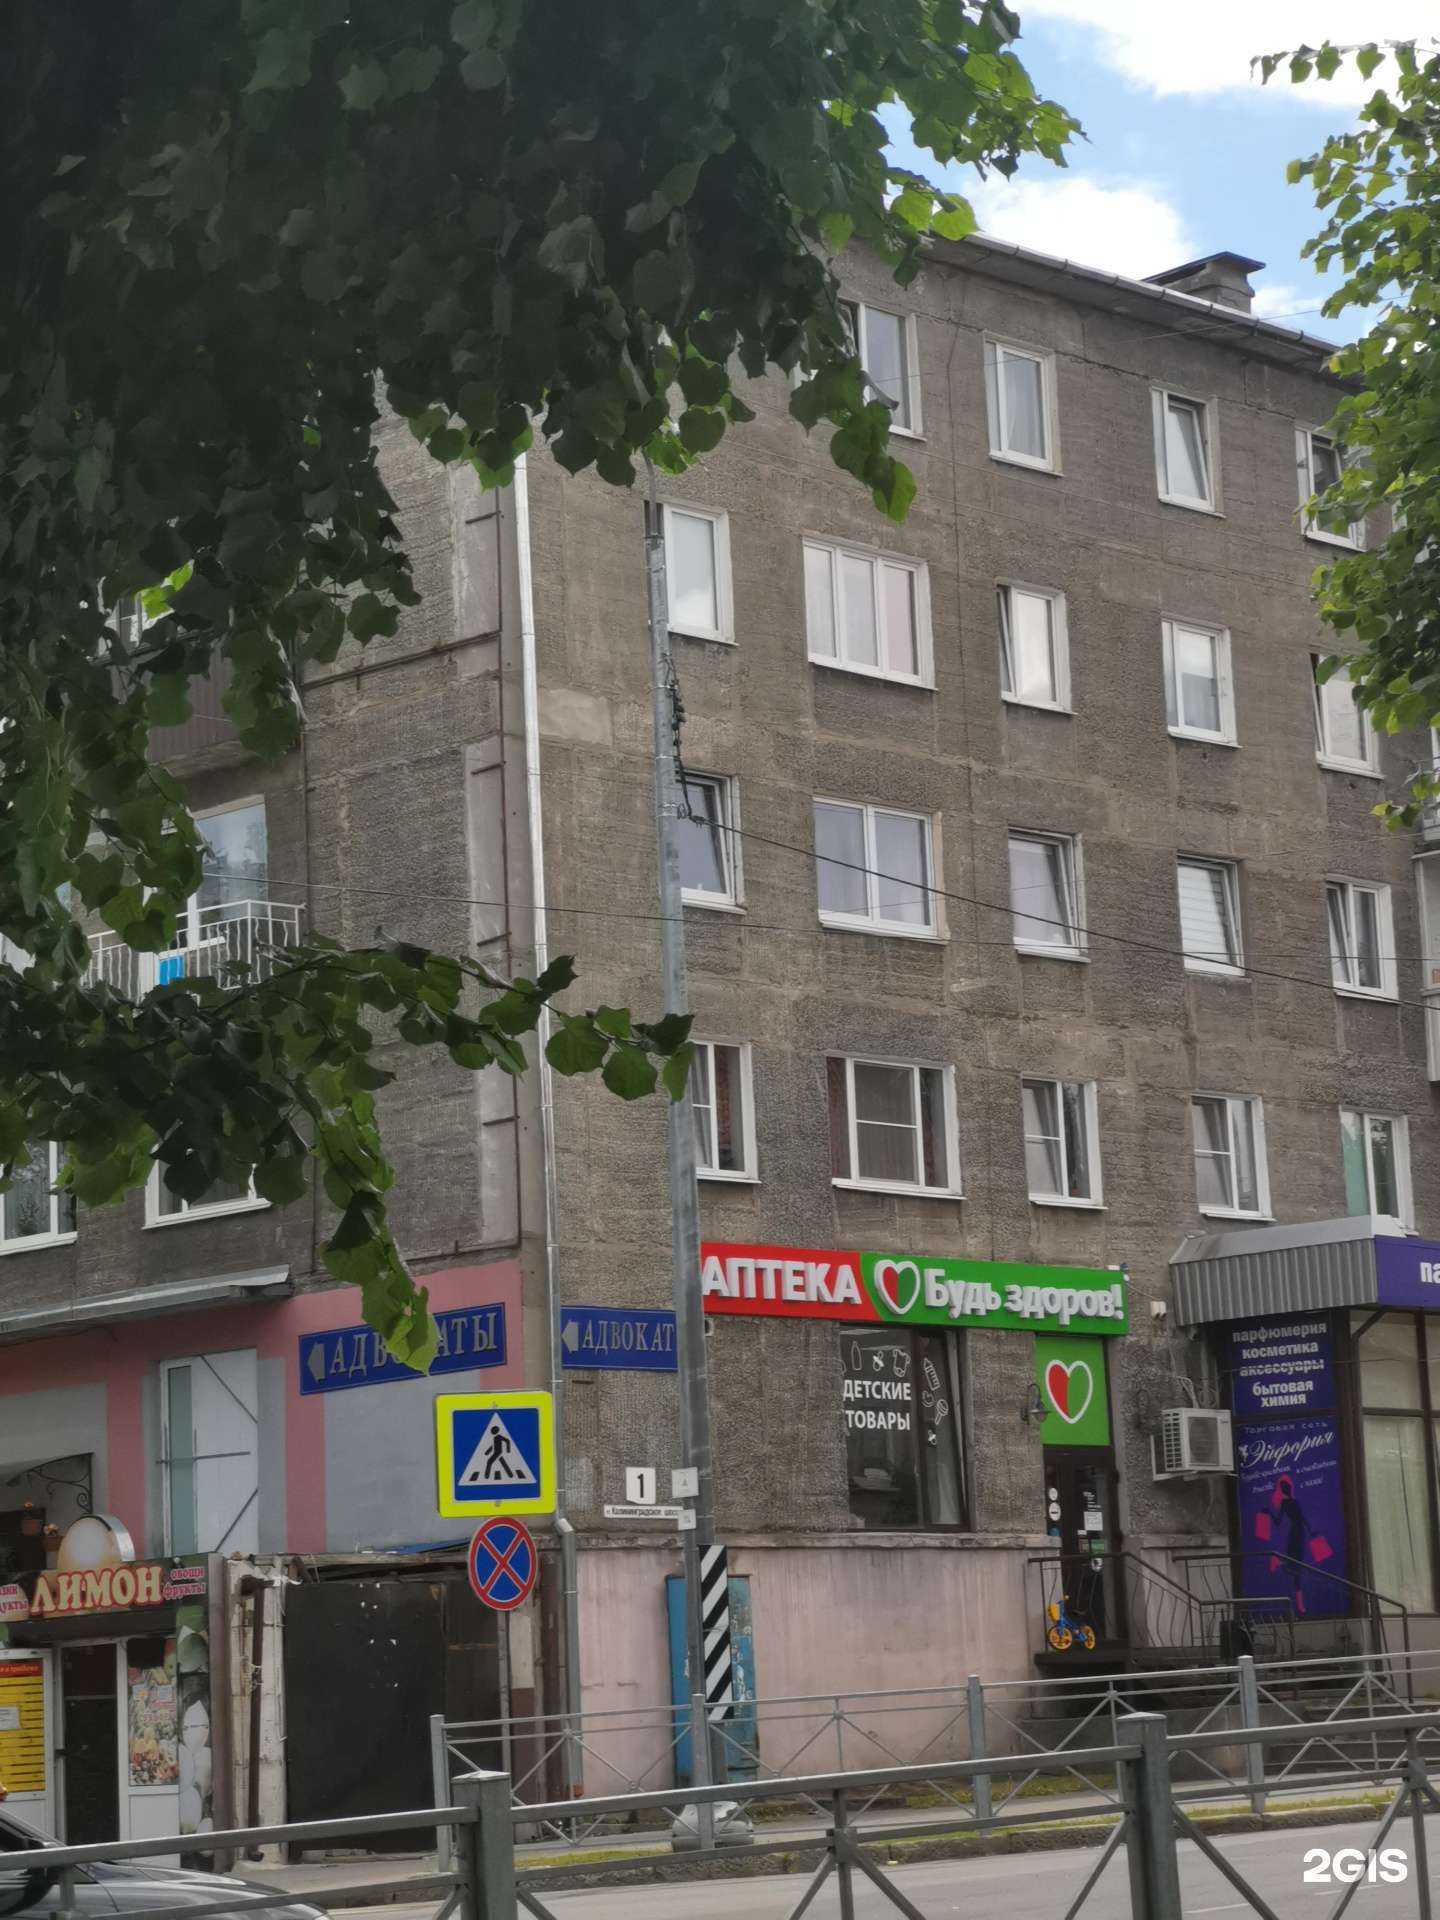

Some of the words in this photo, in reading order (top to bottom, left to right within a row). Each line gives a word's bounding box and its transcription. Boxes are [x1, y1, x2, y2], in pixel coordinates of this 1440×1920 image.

[702, 1256, 862, 1304] АПТЕКА
[924, 1268, 1001, 1319] Будь
[1004, 1283, 1124, 1326] здоров!
[582, 1319, 674, 1356] АДВОКАТ
[1232, 1322, 1327, 1343] парфюмерия
[330, 1312, 497, 1377] АДВАТЫ
[1242, 1341, 1319, 1359] косметика
[1240, 1359, 1324, 1376] аксессуары
[843, 1379, 912, 1402] ДЕТСКИЕ
[1252, 1380, 1313, 1396] бытовая
[1261, 1393, 1306, 1407] химия
[845, 1409, 910, 1431] ТОВАРЫ
[637, 1473, 644, 1498] 1
[31, 1566, 162, 1613] ЛИМОН
